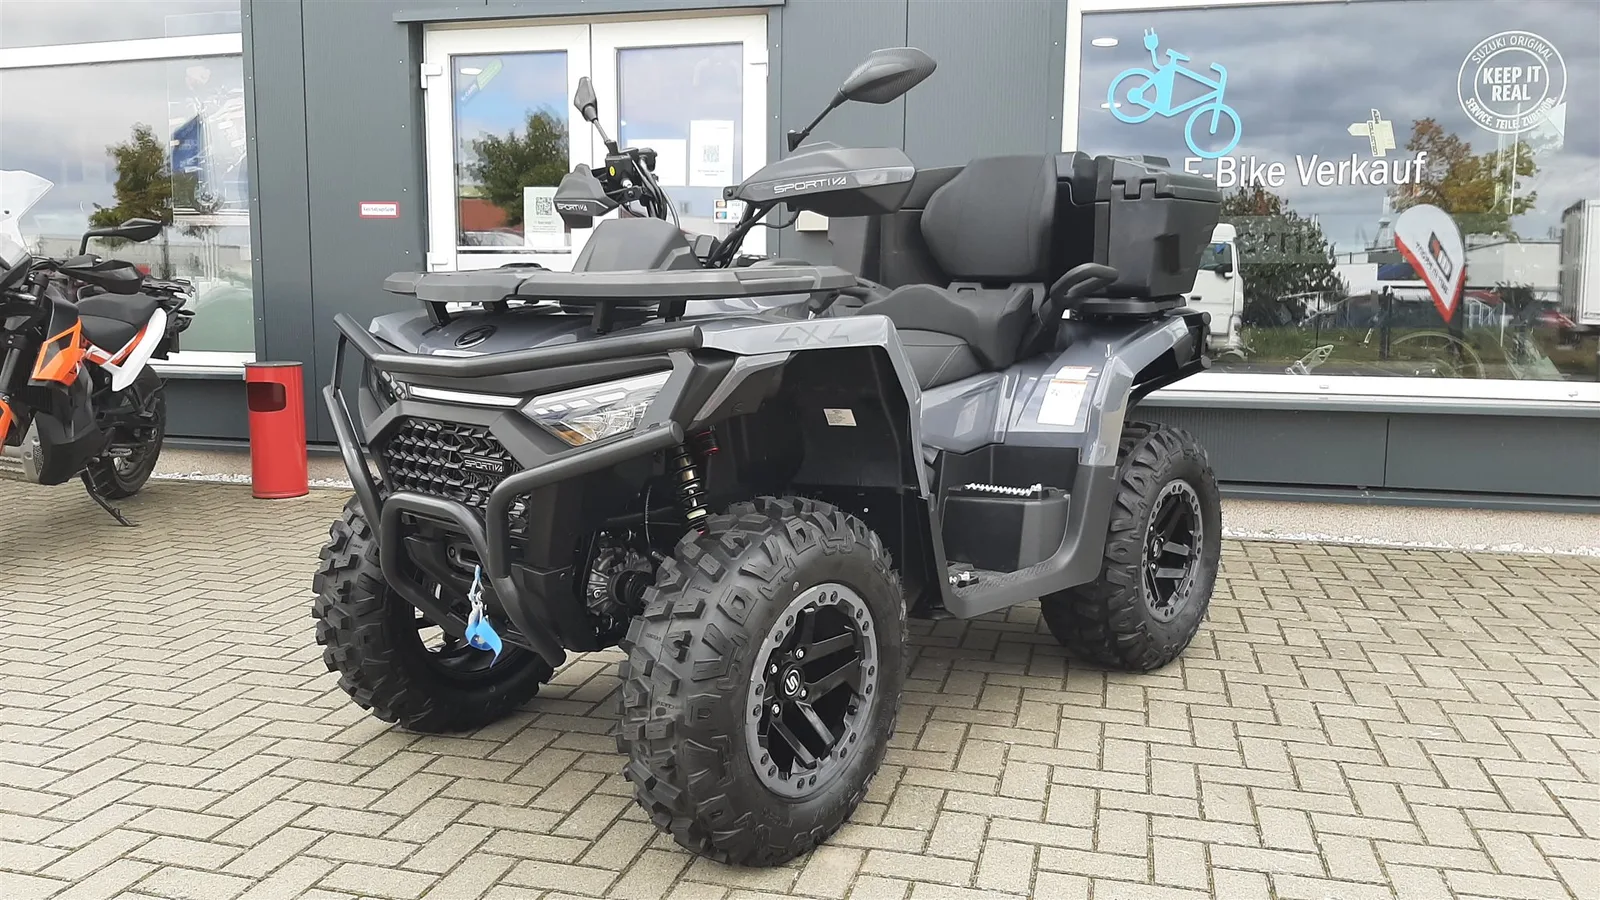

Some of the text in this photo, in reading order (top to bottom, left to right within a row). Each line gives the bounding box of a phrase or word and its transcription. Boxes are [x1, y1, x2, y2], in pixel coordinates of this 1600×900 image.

[1472, 35, 1553, 64] SUZUKI ORIGINAL
[1483, 65, 1542, 85] KEEP IT
[1491, 83, 1531, 102] REAL
[1295, 151, 1428, 187] Verkauf
[773, 176, 847, 194] SPORTIVA
[556, 202, 588, 212] SPORTIVA
[464, 459, 503, 473] SPORTIVA
